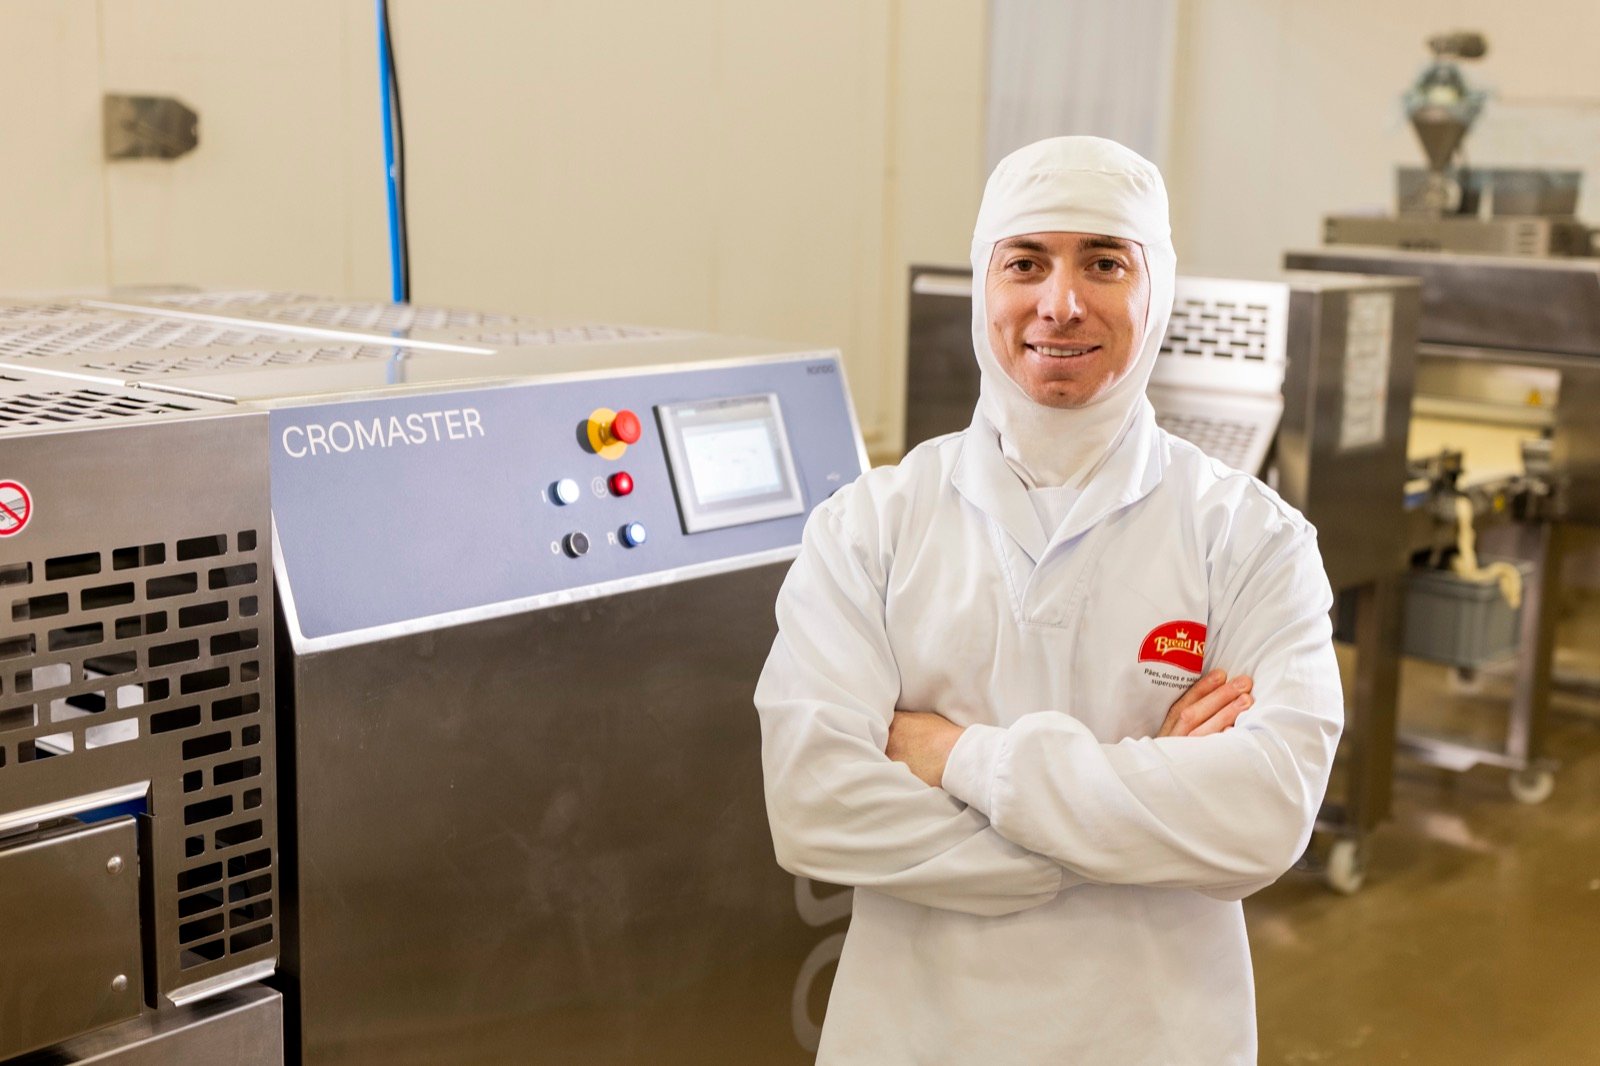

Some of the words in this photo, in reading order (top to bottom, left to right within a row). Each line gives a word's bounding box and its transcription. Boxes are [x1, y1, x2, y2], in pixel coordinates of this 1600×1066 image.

[282, 408, 485, 458] CROMASTER
[607, 531, 617, 545] R
[1154, 636, 1191, 656] Bread
[1144, 668, 1161, 678] Pães,
[1162, 672, 1180, 681] doces
